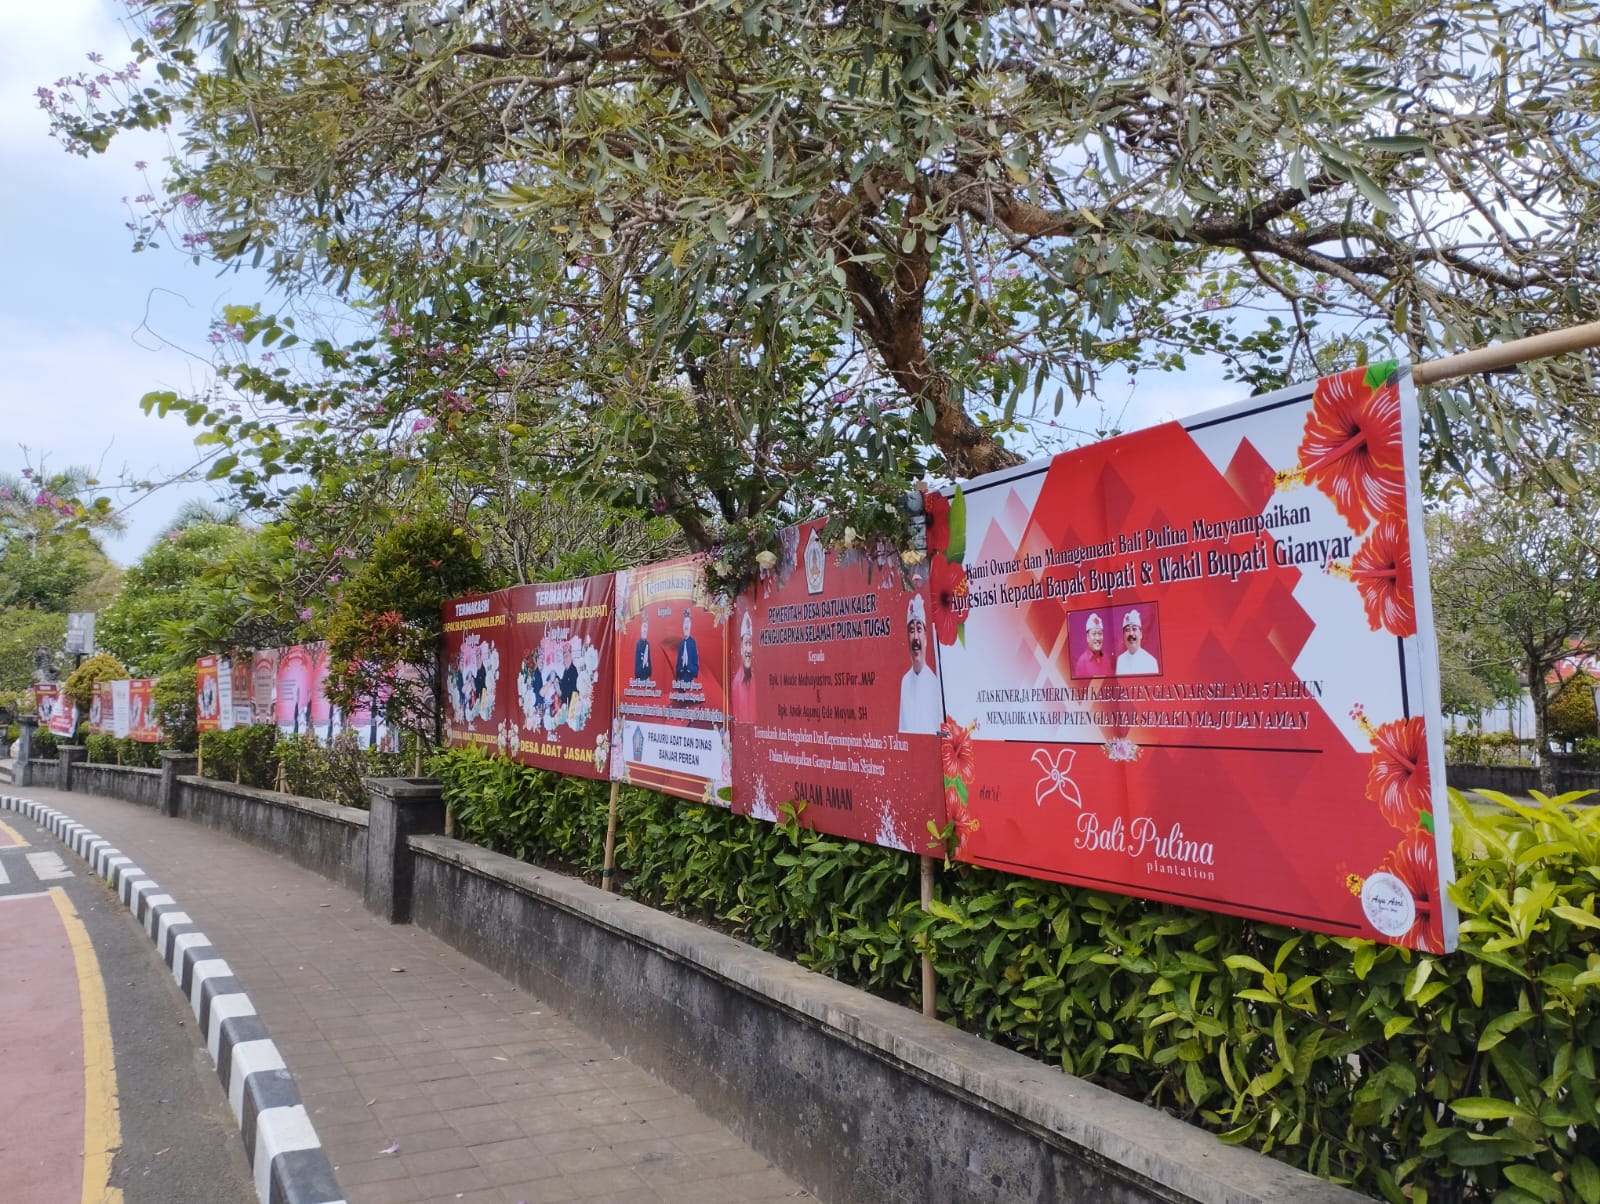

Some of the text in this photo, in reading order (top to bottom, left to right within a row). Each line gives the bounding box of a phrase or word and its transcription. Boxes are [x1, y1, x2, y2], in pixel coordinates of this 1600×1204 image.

[965, 504, 1311, 581] Kami Owner dan Management Bali Pulina Menyampaikan
[950, 535, 1353, 616] Apresiasi Kepada Bapak Bupati & Wakil Bupati Gianyar
[585, 604, 608, 618] BUPATI
[803, 602, 820, 620] DESA
[821, 598, 850, 619] BATUAN
[852, 593, 877, 614] KALER
[760, 616, 891, 646] MENGUCAPKAN SELAMAT PURNA TUGAS
[976, 679, 1324, 704] ATAS KINERJA PEMERINTAH KABUPATEN GIANYAR SELAMA 5 TAHUN
[858, 706, 867, 720] SH
[986, 710, 1309, 730] MENJADIKAN KABUPATEN GIANYAR SEMAKIN MAJU DAN AMAN
[520, 740, 592, 762] DESA ADAT JASAN
[670, 734, 682, 747] ADAT
[683, 737, 694, 749] DAN
[695, 738, 712, 751] DINAS
[883, 735, 888, 750] 5
[888, 733, 909, 752] Tahun
[659, 749, 678, 761] BANJAR
[848, 757, 859, 772] Dan
[794, 781, 853, 811] SALAM AMAN
[978, 785, 1000, 801] dari
[1074, 812, 1214, 866] Bali Pulina
[1146, 859, 1215, 881] plantation
